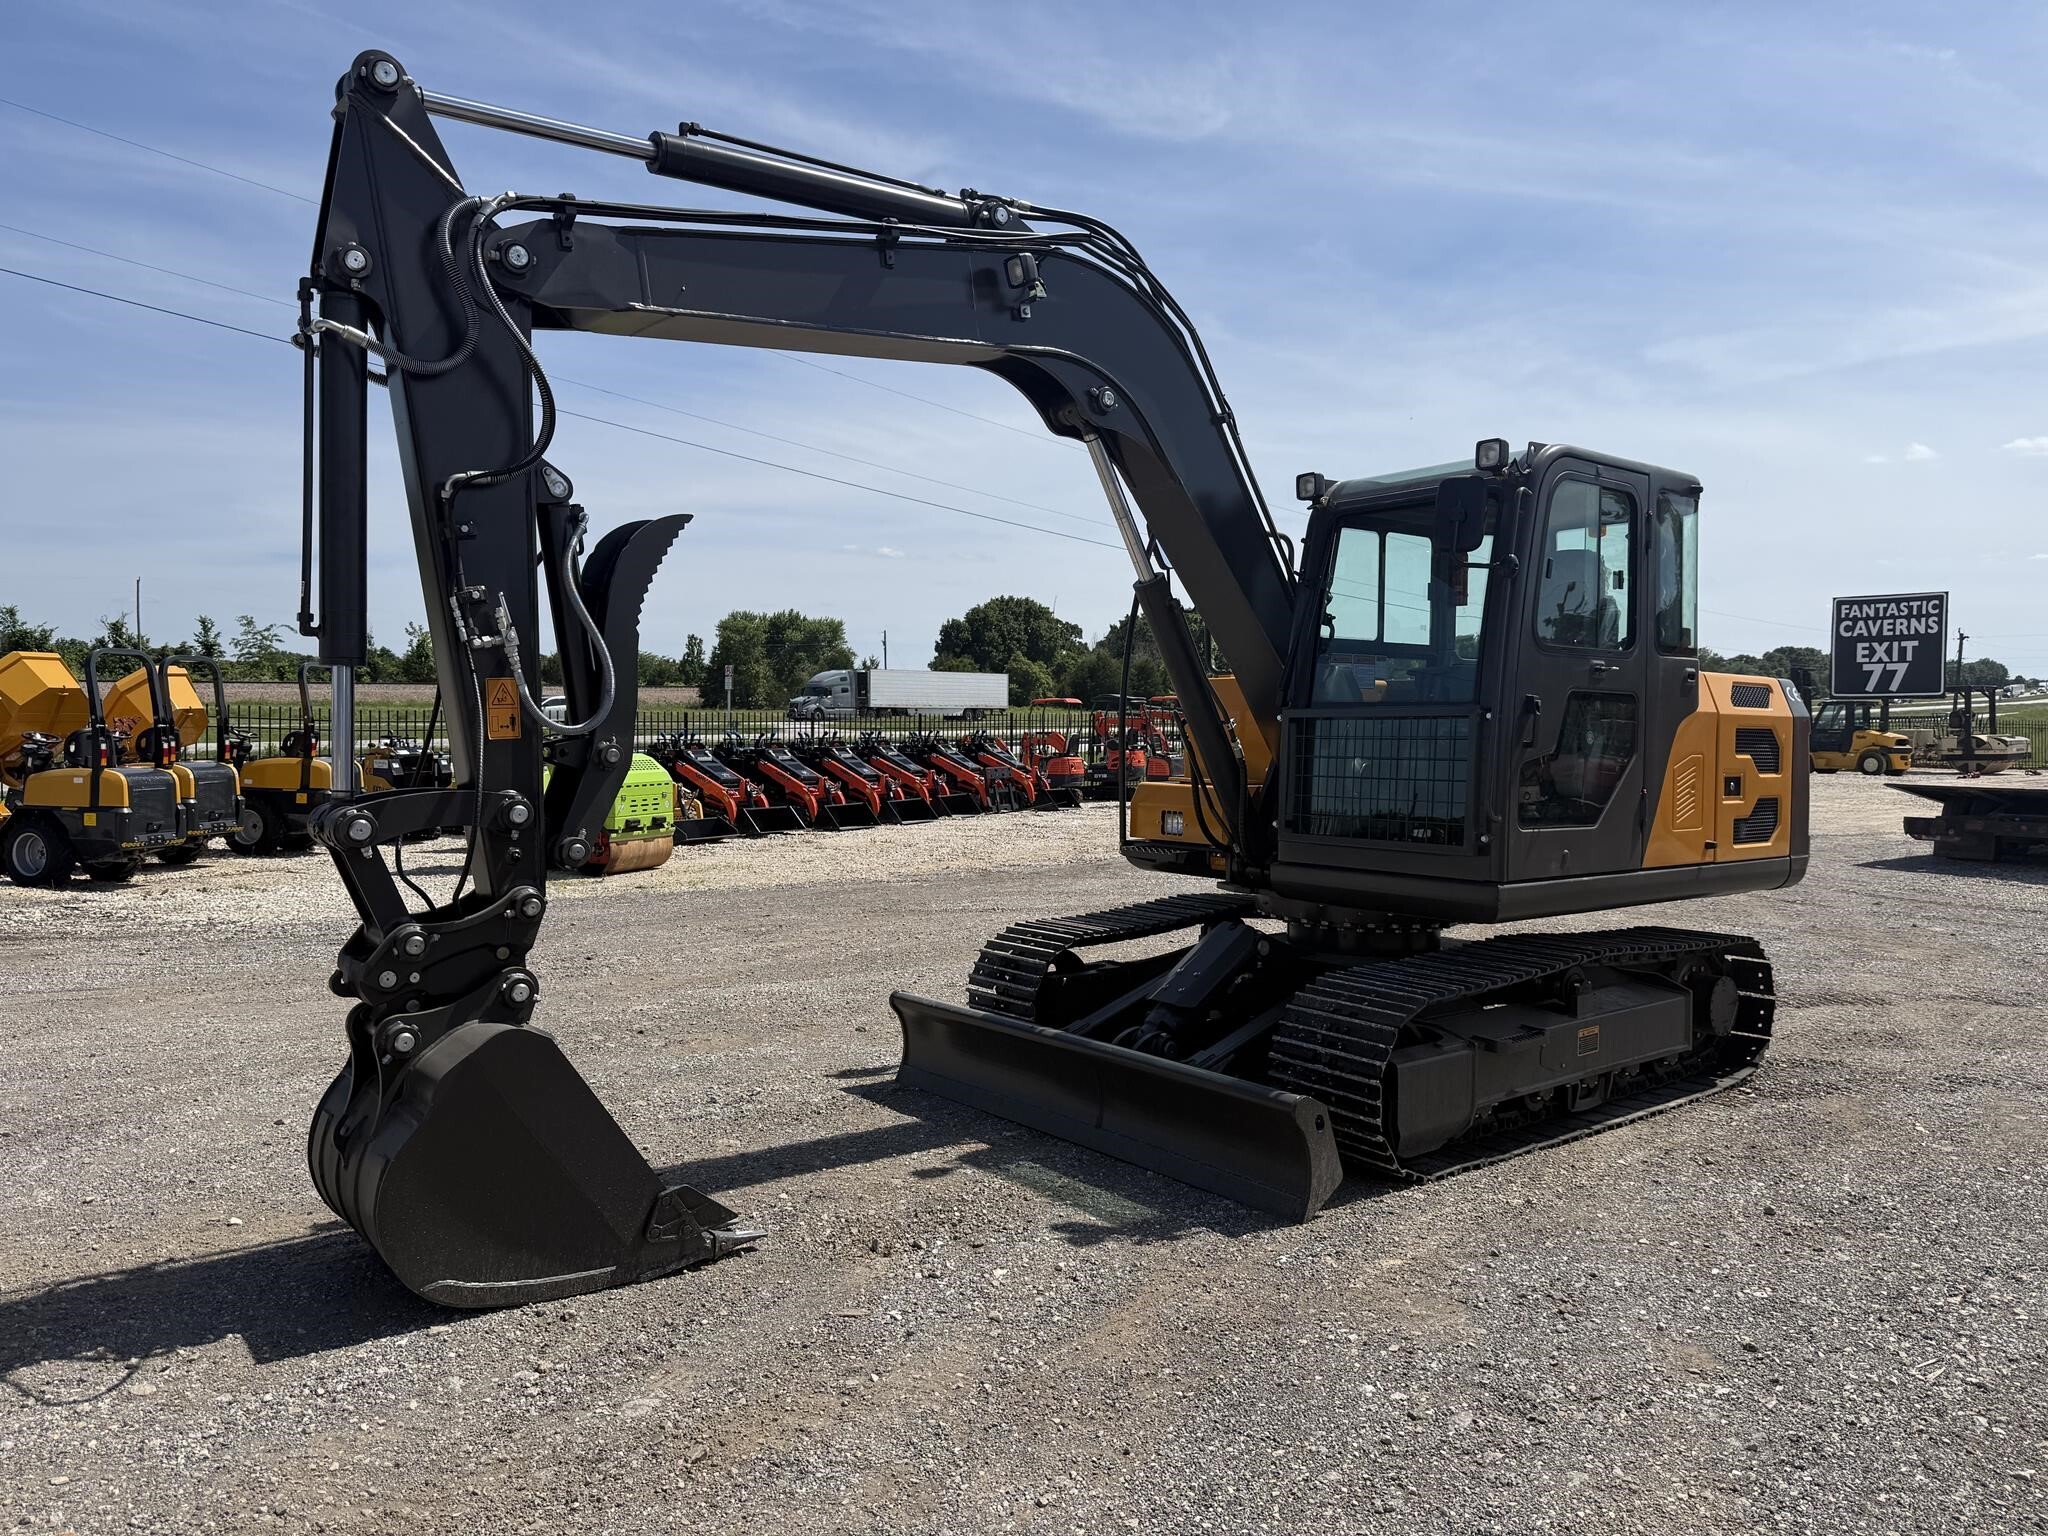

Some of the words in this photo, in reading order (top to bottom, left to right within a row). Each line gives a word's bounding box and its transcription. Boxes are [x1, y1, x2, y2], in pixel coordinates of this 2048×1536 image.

[1840, 600, 1940, 618] FANTASTIC
[1839, 617, 1939, 637] CAVERNS
[1856, 640, 1919, 663] EXIT
[1862, 662, 1910, 692] 77
